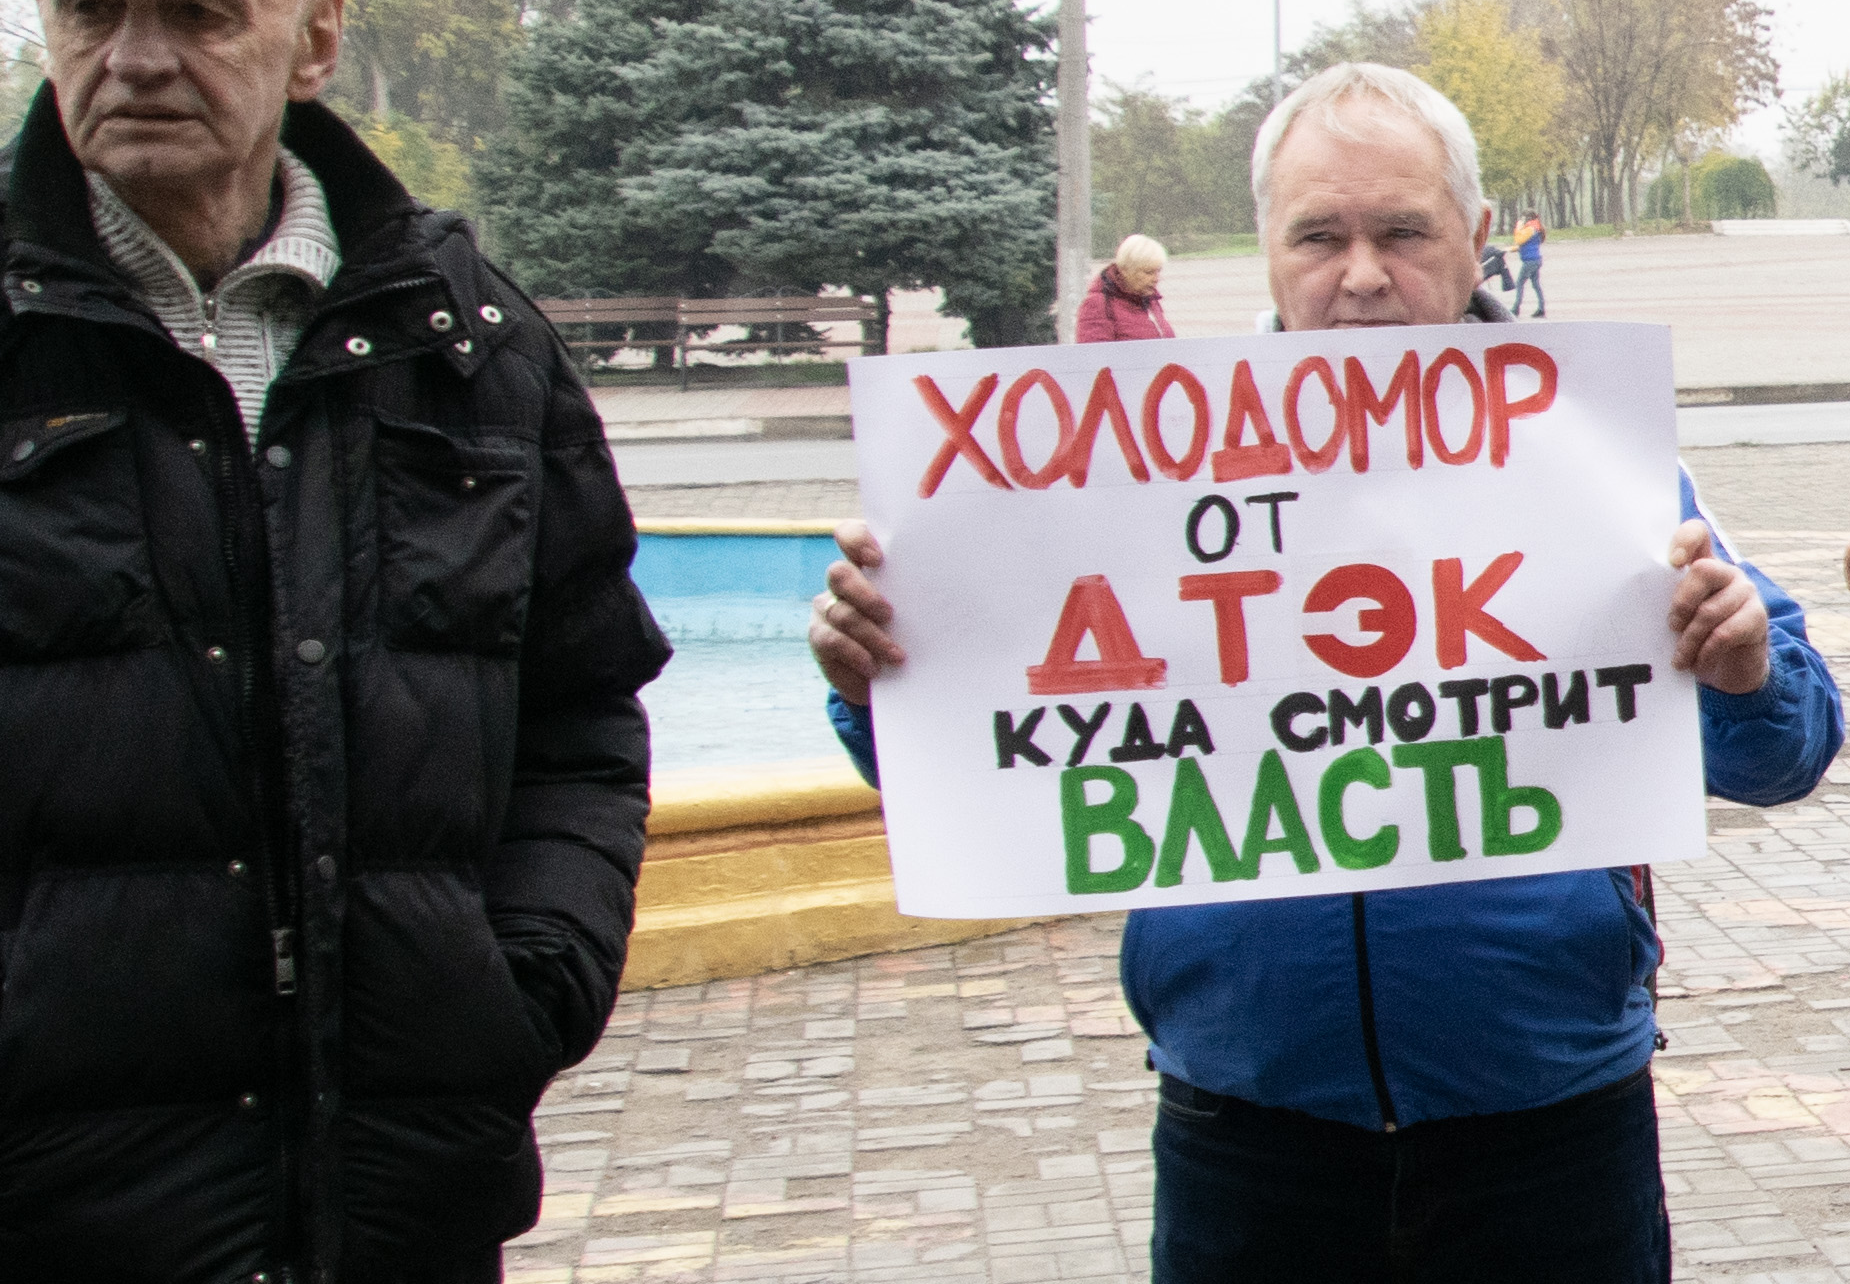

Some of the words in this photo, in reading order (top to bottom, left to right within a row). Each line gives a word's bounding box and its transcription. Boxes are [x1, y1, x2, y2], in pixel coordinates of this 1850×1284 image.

[912, 341, 1559, 499] ХОЛОДОМОР
[1186, 491, 1300, 564] ОТ
[1027, 550, 1548, 696] ДТЭК
[994, 699, 1215, 770] КУДА
[1267, 663, 1653, 756] СМОТРИТ
[1060, 736, 1564, 895] ВЛАСТЬ
